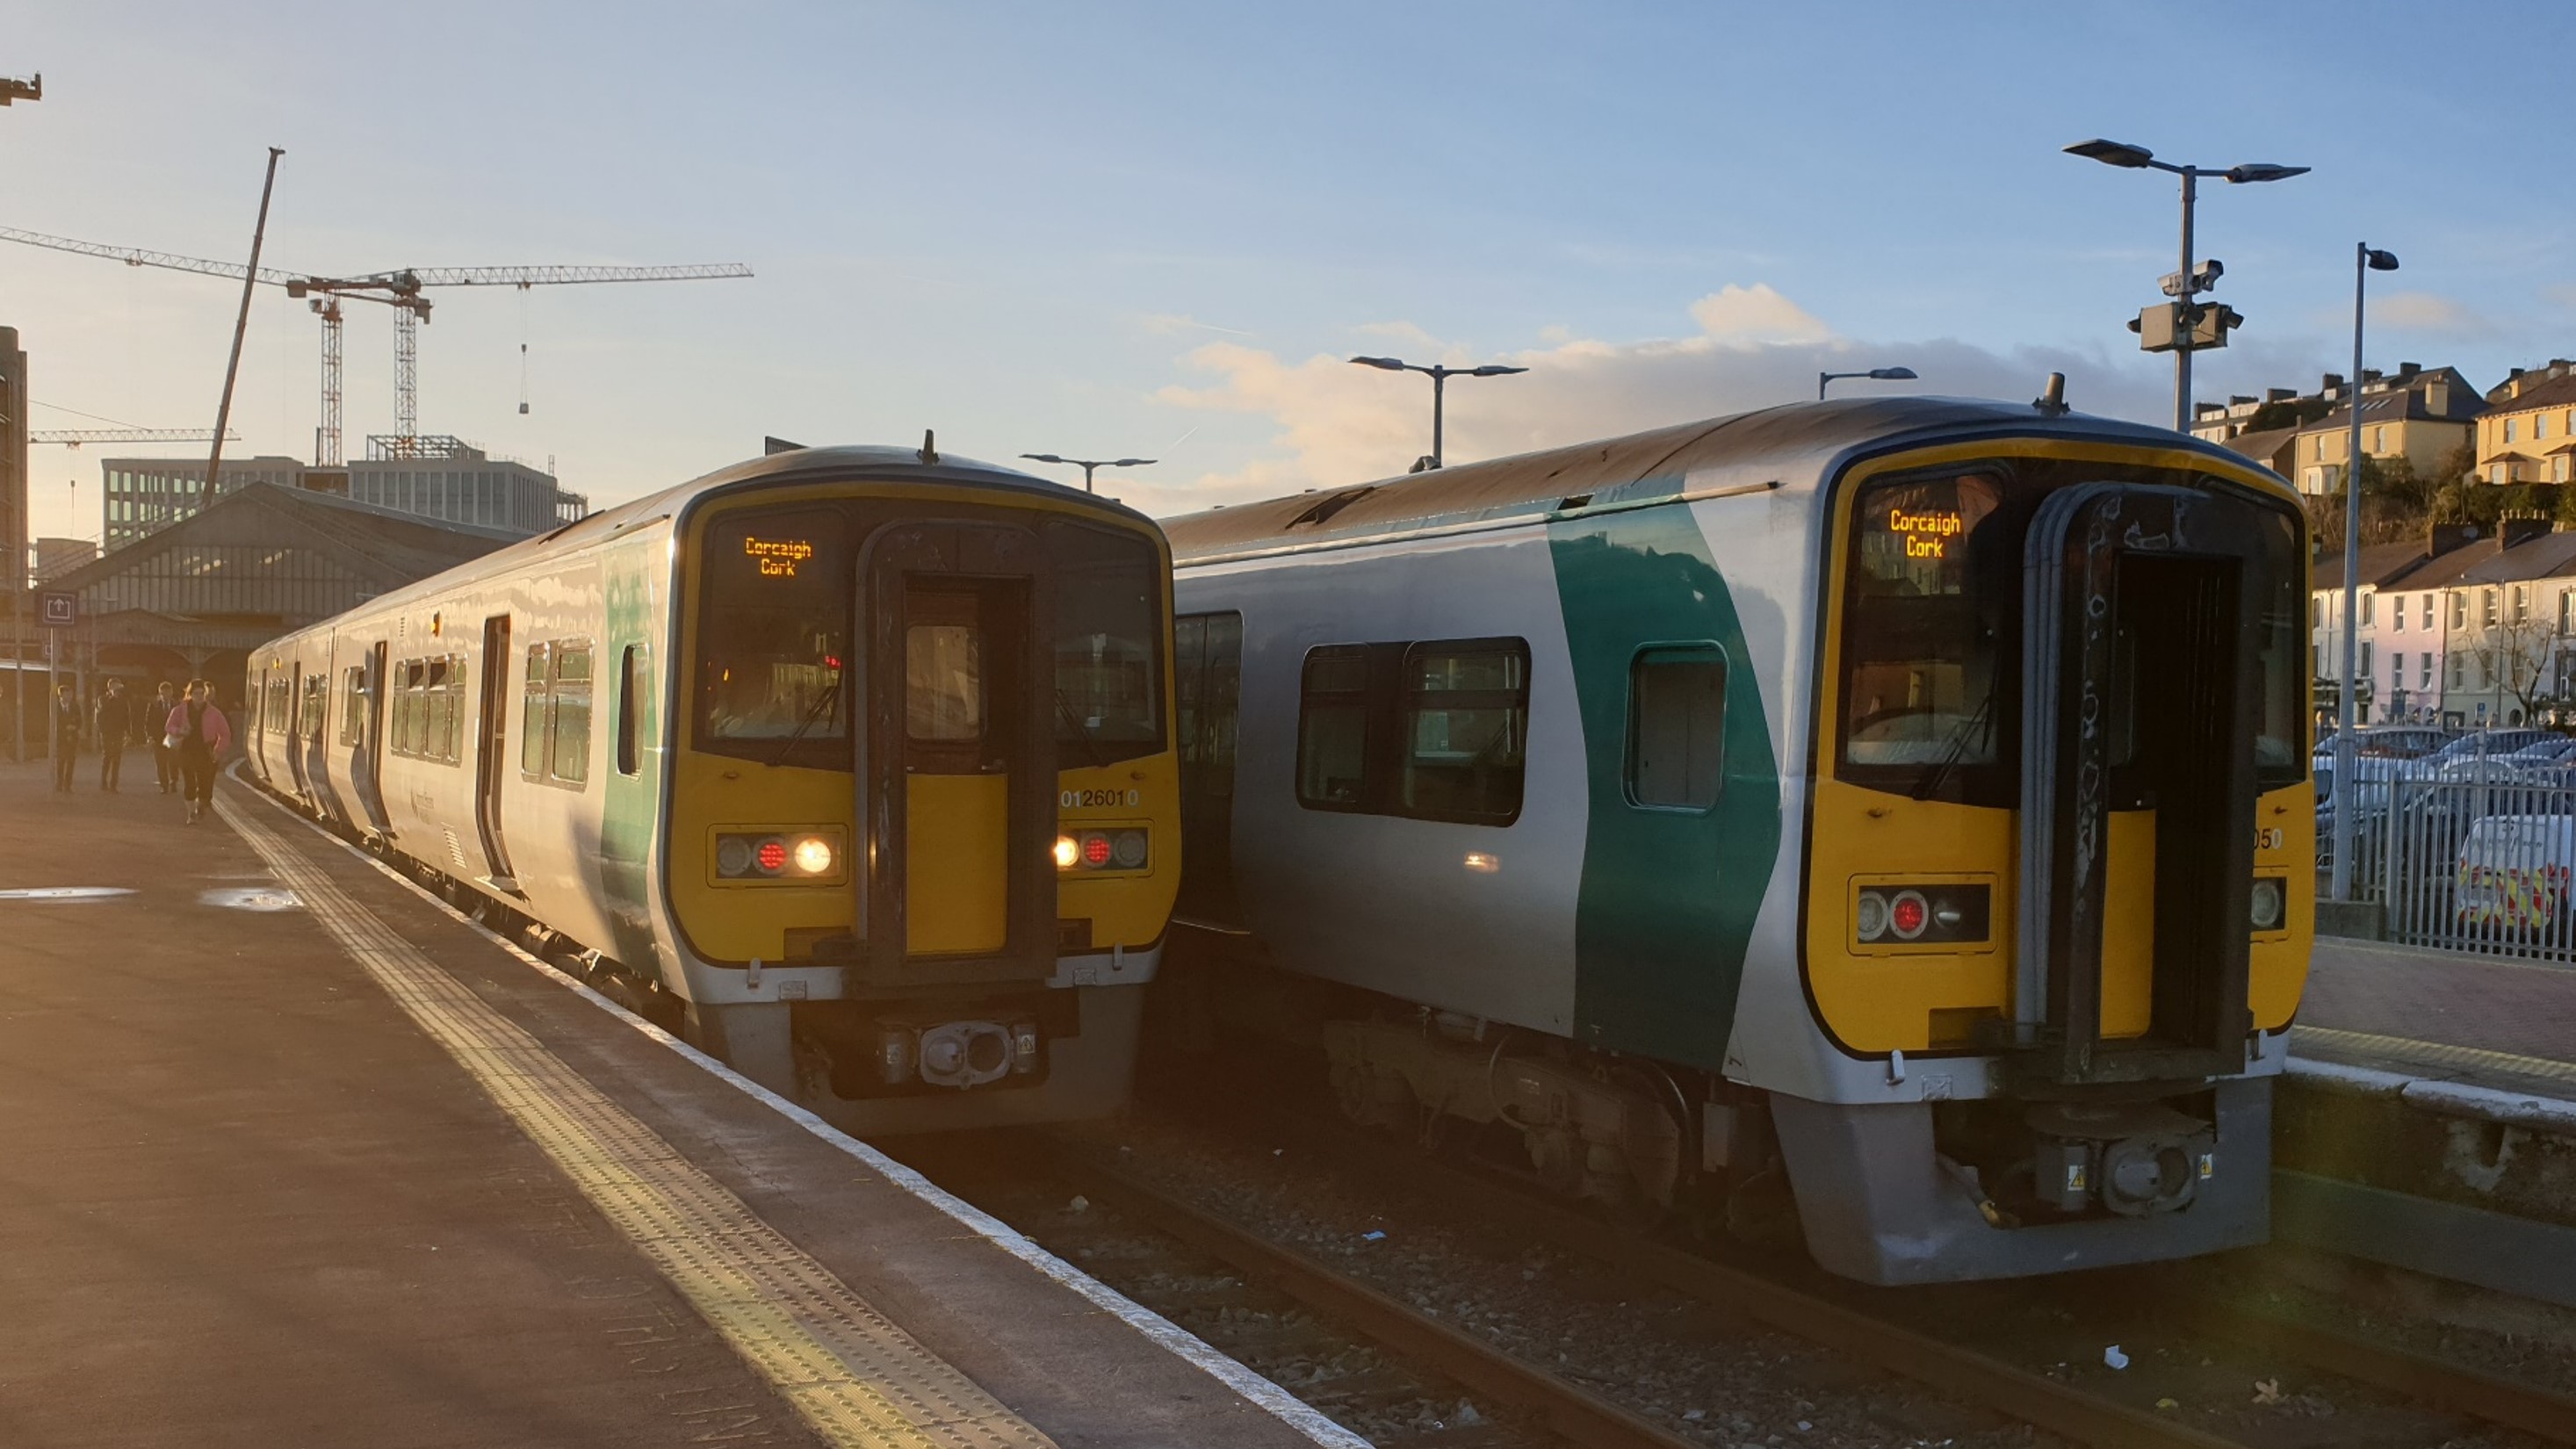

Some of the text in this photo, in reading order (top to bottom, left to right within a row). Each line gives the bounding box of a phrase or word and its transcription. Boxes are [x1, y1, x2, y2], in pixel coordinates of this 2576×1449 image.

[1891, 509, 1960, 537] Corcaigh
[746, 537, 812, 559] Corcaigh
[1907, 535, 1943, 558] Cork
[761, 558, 796, 576] Cork
[1061, 789, 1139, 807] 0126010
